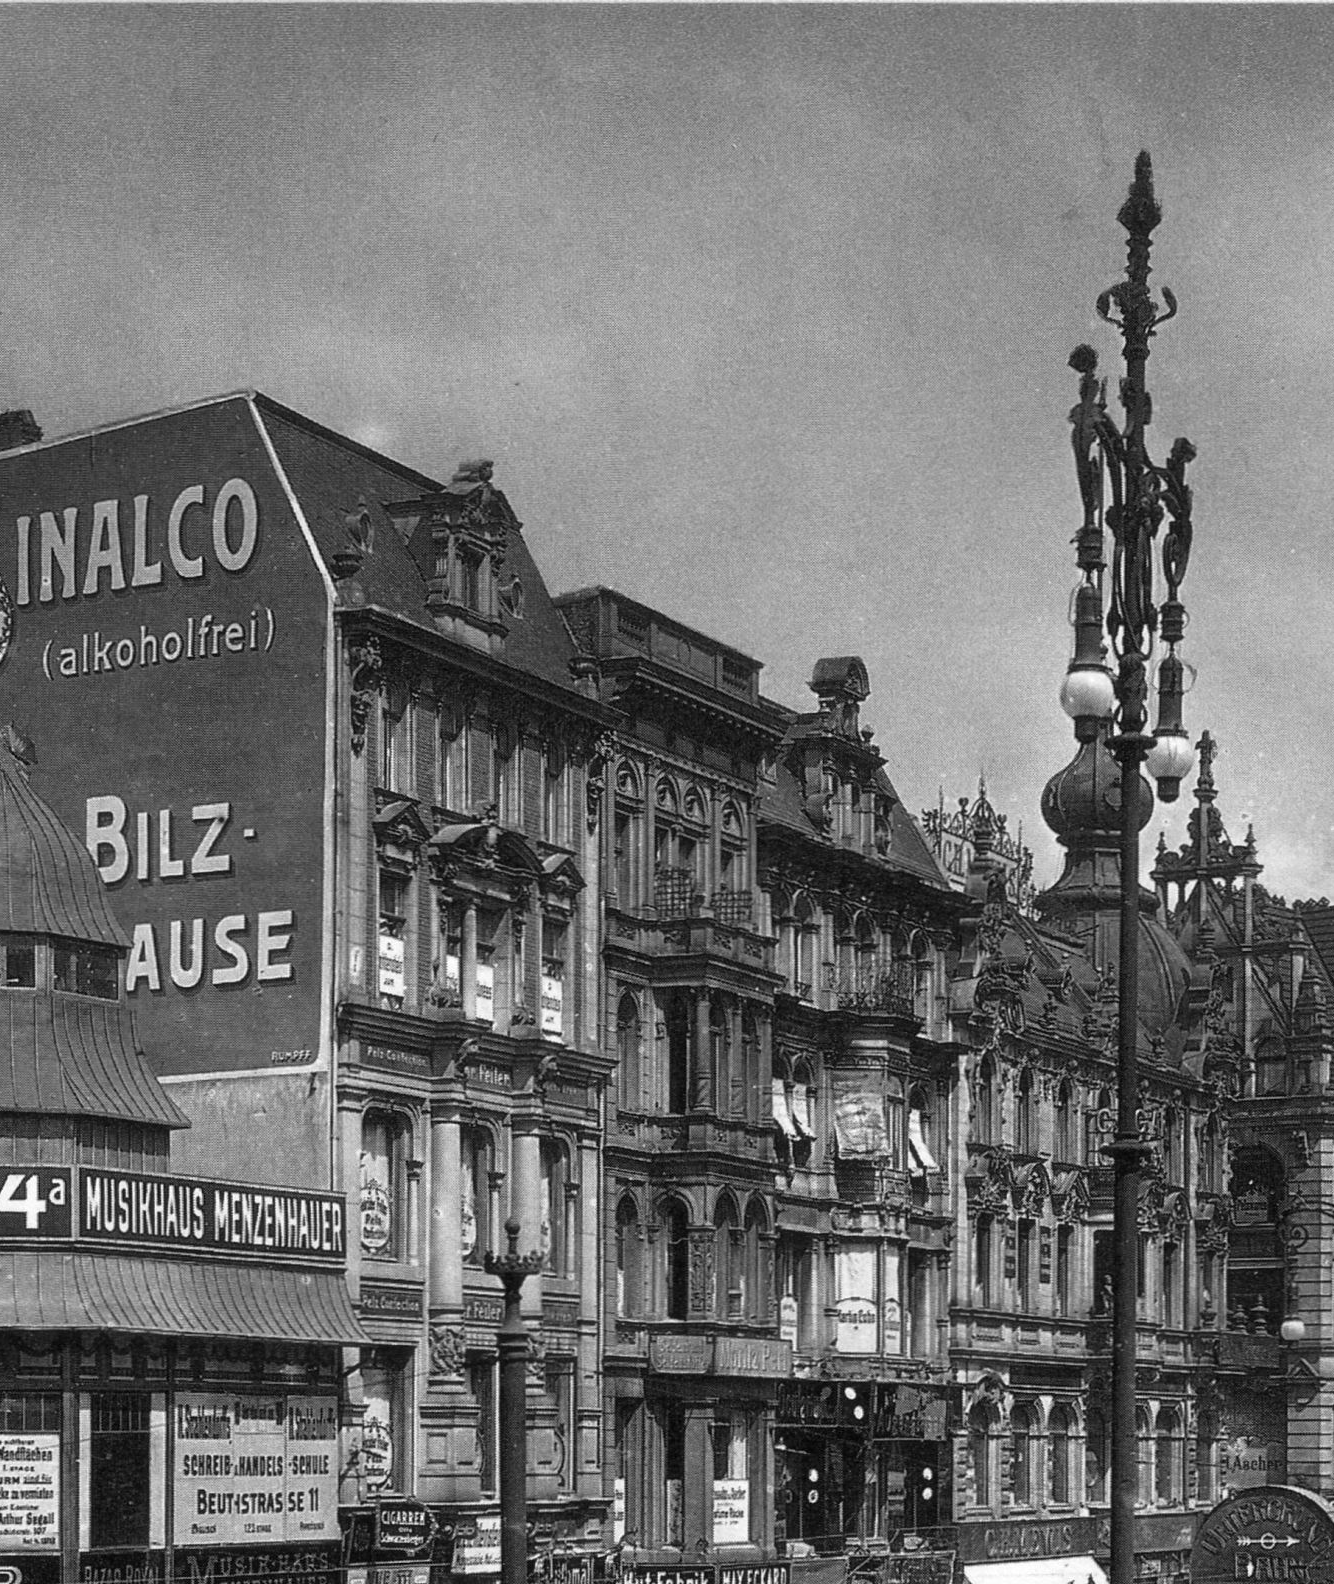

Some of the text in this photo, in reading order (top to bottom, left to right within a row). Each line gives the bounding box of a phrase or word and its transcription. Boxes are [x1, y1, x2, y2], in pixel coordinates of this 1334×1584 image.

[43, 608, 276, 682] (alkoholfrei)
[85, 1176, 205, 1240] MUSIKHAUS
[214, 1190, 343, 1253] MENZENHAUER
[26, 1512, 55, 1526] Segall
[381, 1510, 426, 1526] CIGARREN
